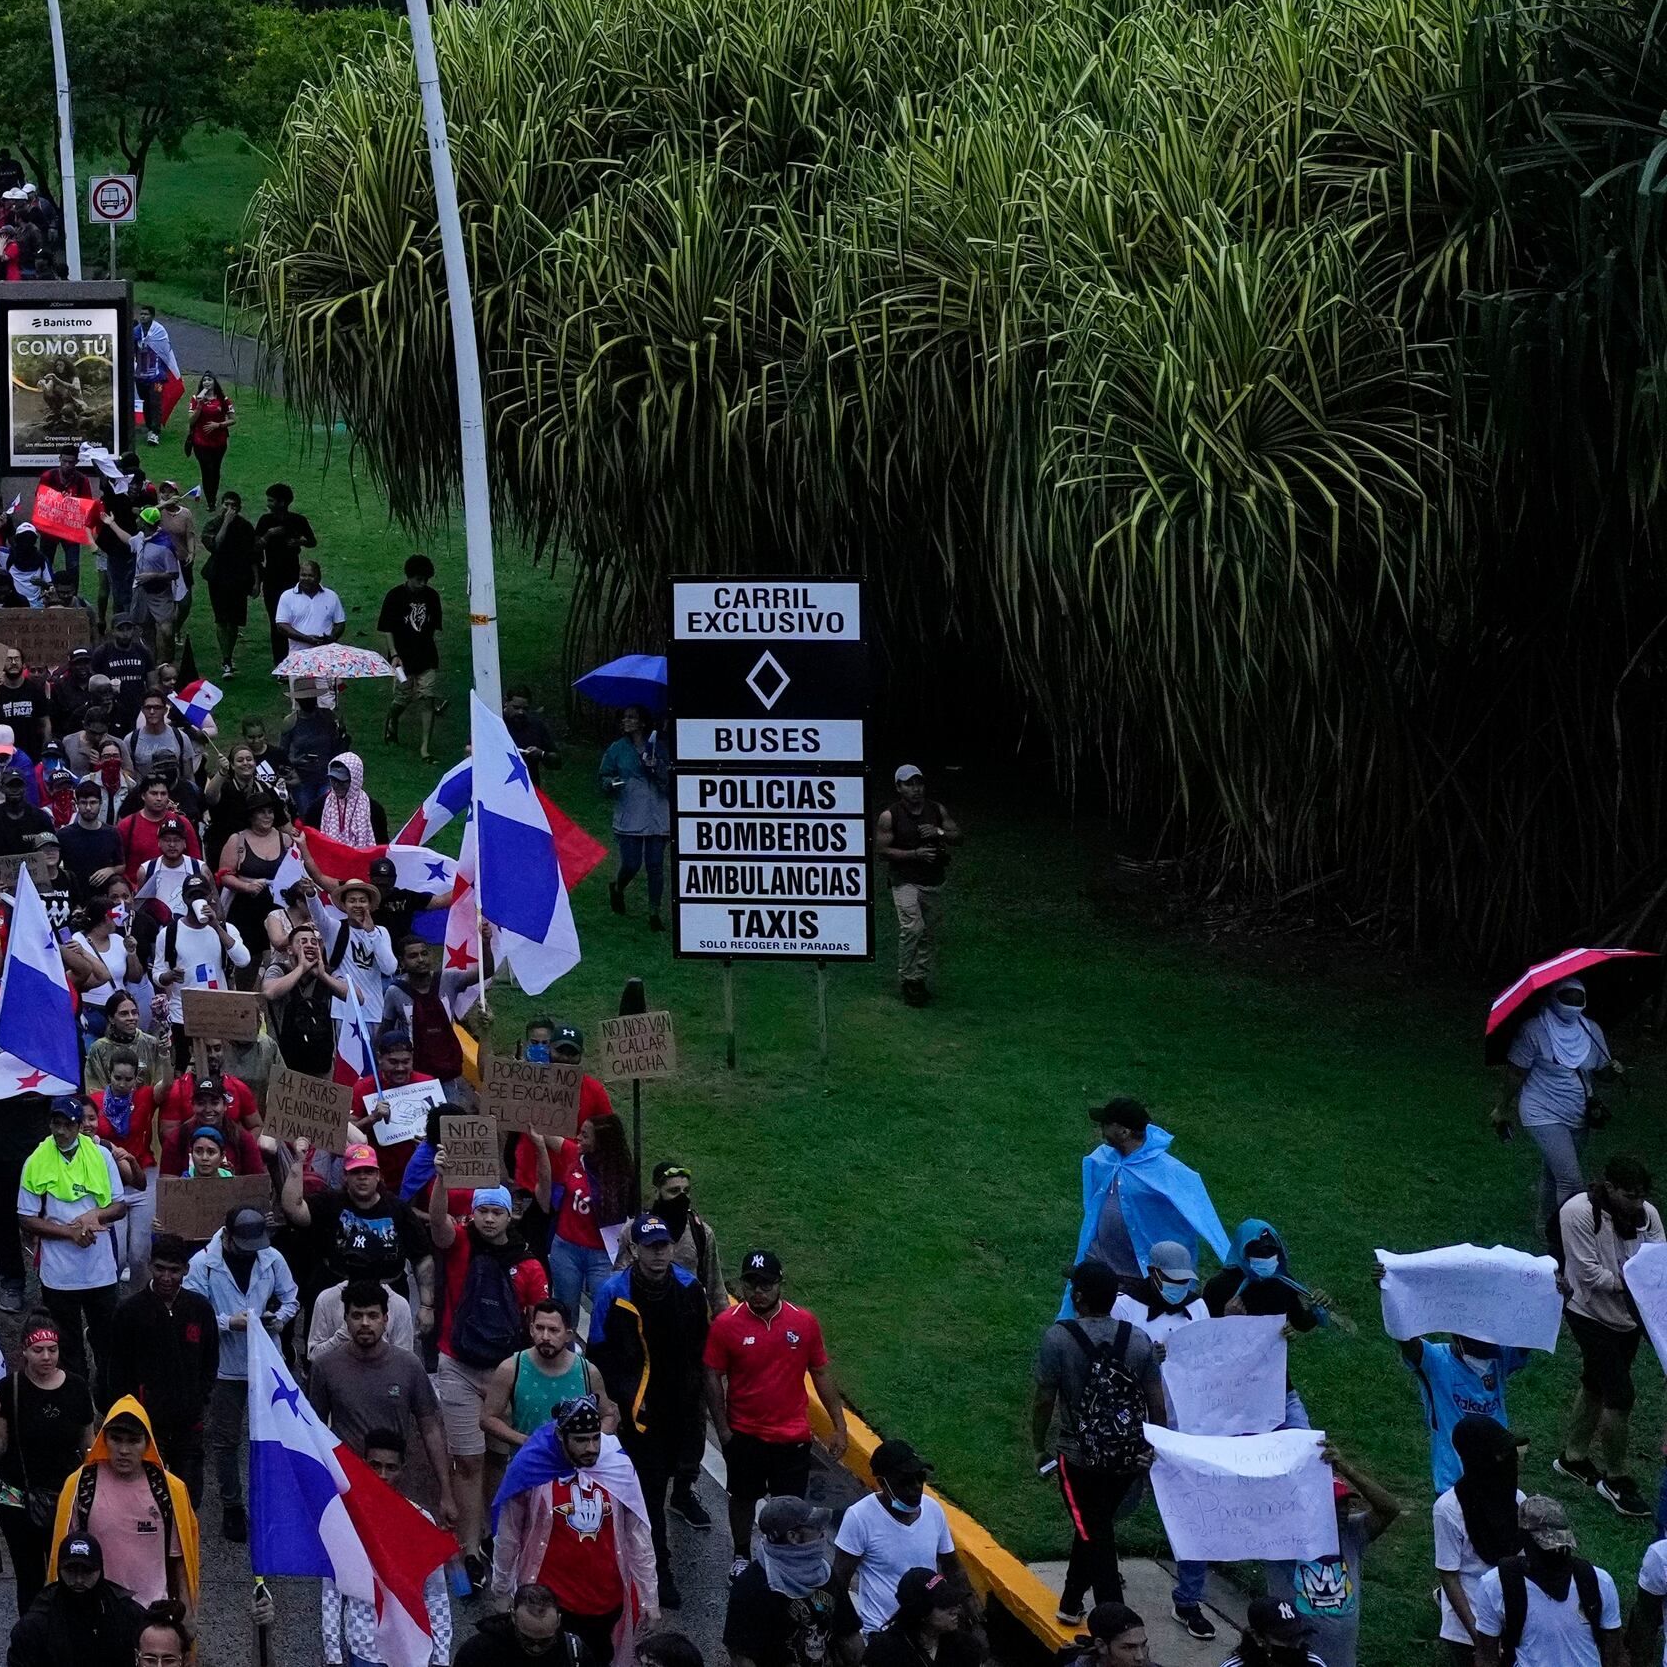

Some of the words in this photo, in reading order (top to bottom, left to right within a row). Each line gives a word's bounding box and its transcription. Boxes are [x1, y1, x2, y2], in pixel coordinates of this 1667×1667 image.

[43, 318, 93, 327] Banistmo
[17, 340, 78, 356] COMO
[82, 335, 107, 355] TÚ
[713, 587, 818, 609] CARRIL
[687, 611, 845, 634] EXCLUSIVO
[109, 659, 141, 668] HOLLISTER
[4, 709, 12, 717] TE
[13, 708, 33, 716] PASA?
[714, 727, 821, 753] BUSES
[52, 772, 70, 780] ROXY
[698, 779, 836, 810] POLICIAS
[696, 822, 848, 853] BOMBEROS
[685, 865, 861, 897] AMBULANCIAS
[728, 909, 819, 939] TAXIS
[699, 940, 727, 949] SOLO
[730, 941, 780, 950] RECOGER
[783, 942, 798, 951] EN
[800, 942, 850, 952] PARADAS
[602, 1022, 620, 1038] NO
[624, 1019, 647, 1038] NOS
[649, 1014, 671, 1033] VAN
[607, 1041, 615, 1055] A
[618, 1034, 668, 1054] CALLAR
[492, 1061, 549, 1084] PORQUE
[557, 1069, 578, 1087] NO
[612, 1054, 667, 1075] CHUCHA
[277, 1073, 295, 1093] 44
[299, 1078, 339, 1105] RATAS
[488, 1082, 508, 1100] SE
[513, 1084, 574, 1109] EXCAVAN
[276, 1095, 342, 1127] VENDIERON
[490, 1105, 511, 1123] EL
[516, 1106, 568, 1127] CULO
[268, 1117, 279, 1134] A
[280, 1118, 336, 1148] PANAMÁ
[448, 1122, 488, 1138] NITO
[444, 1142, 488, 1156] VENDE
[641, 1224, 667, 1233] Corona
[352, 1235, 366, 1249] NY
[751, 1254, 765, 1268] NY
[1278, 1602, 1295, 1620] NY
